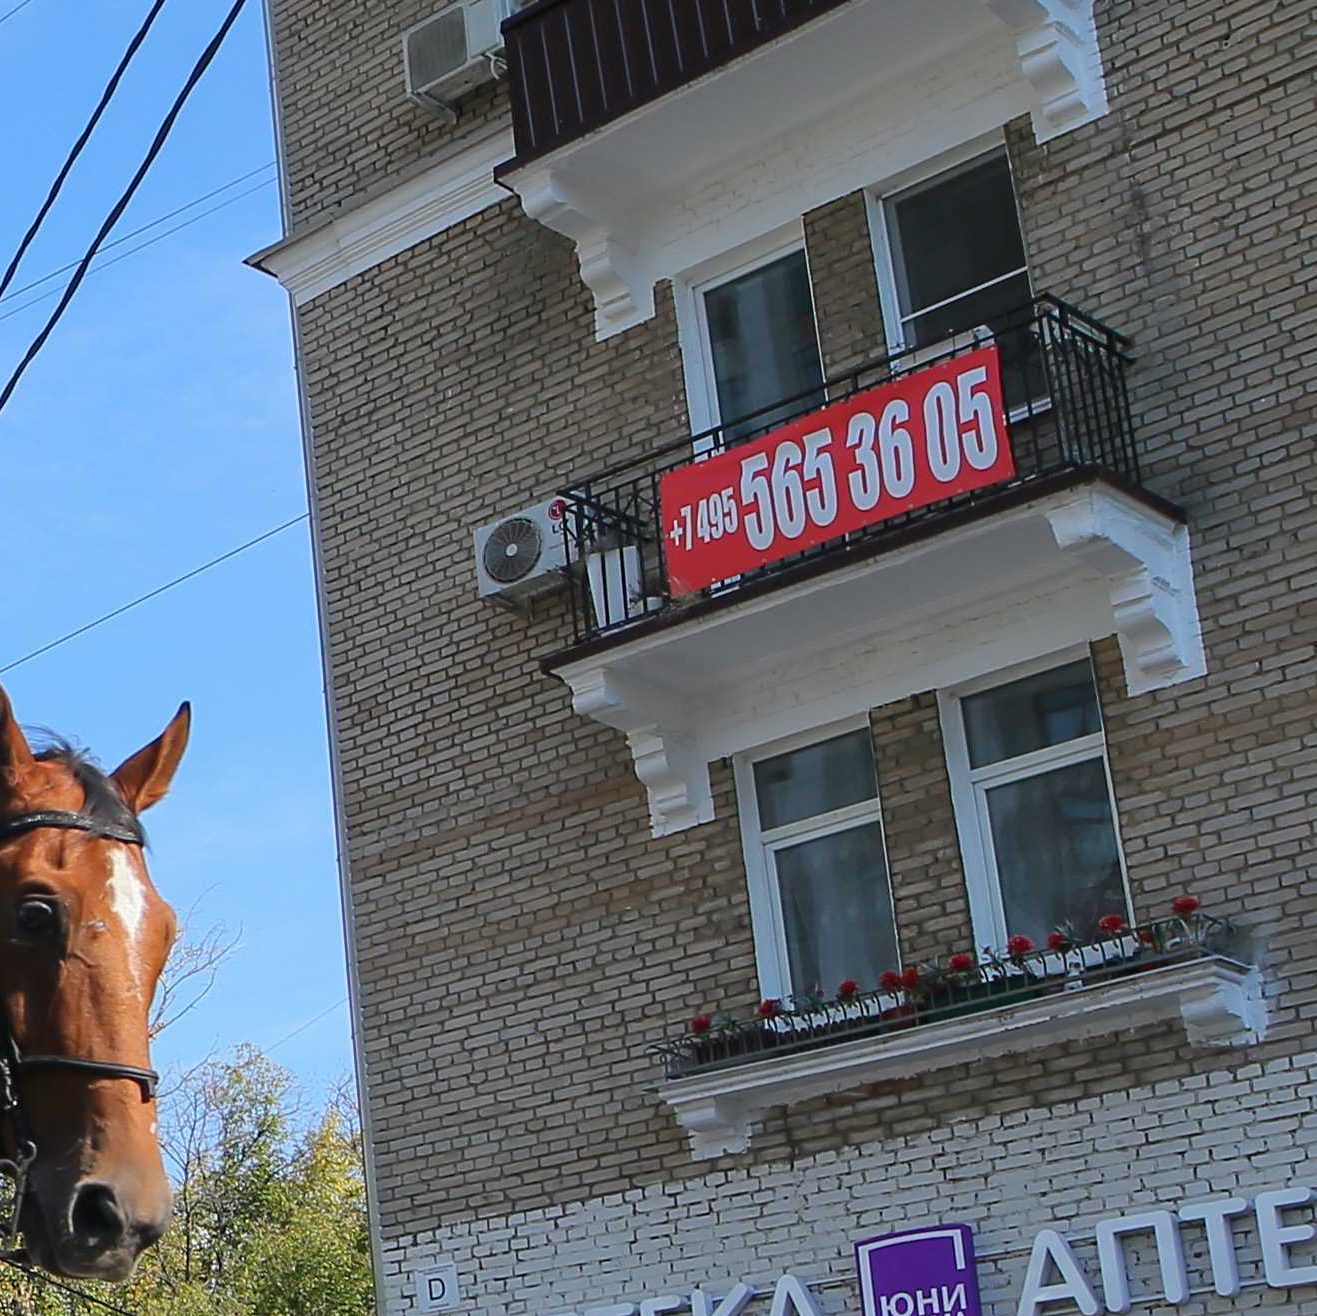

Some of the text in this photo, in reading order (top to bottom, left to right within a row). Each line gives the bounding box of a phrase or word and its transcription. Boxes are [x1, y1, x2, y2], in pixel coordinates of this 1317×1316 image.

[669, 365, 998, 551] +7 495 565 36 05
[428, 1277, 446, 1301] D
